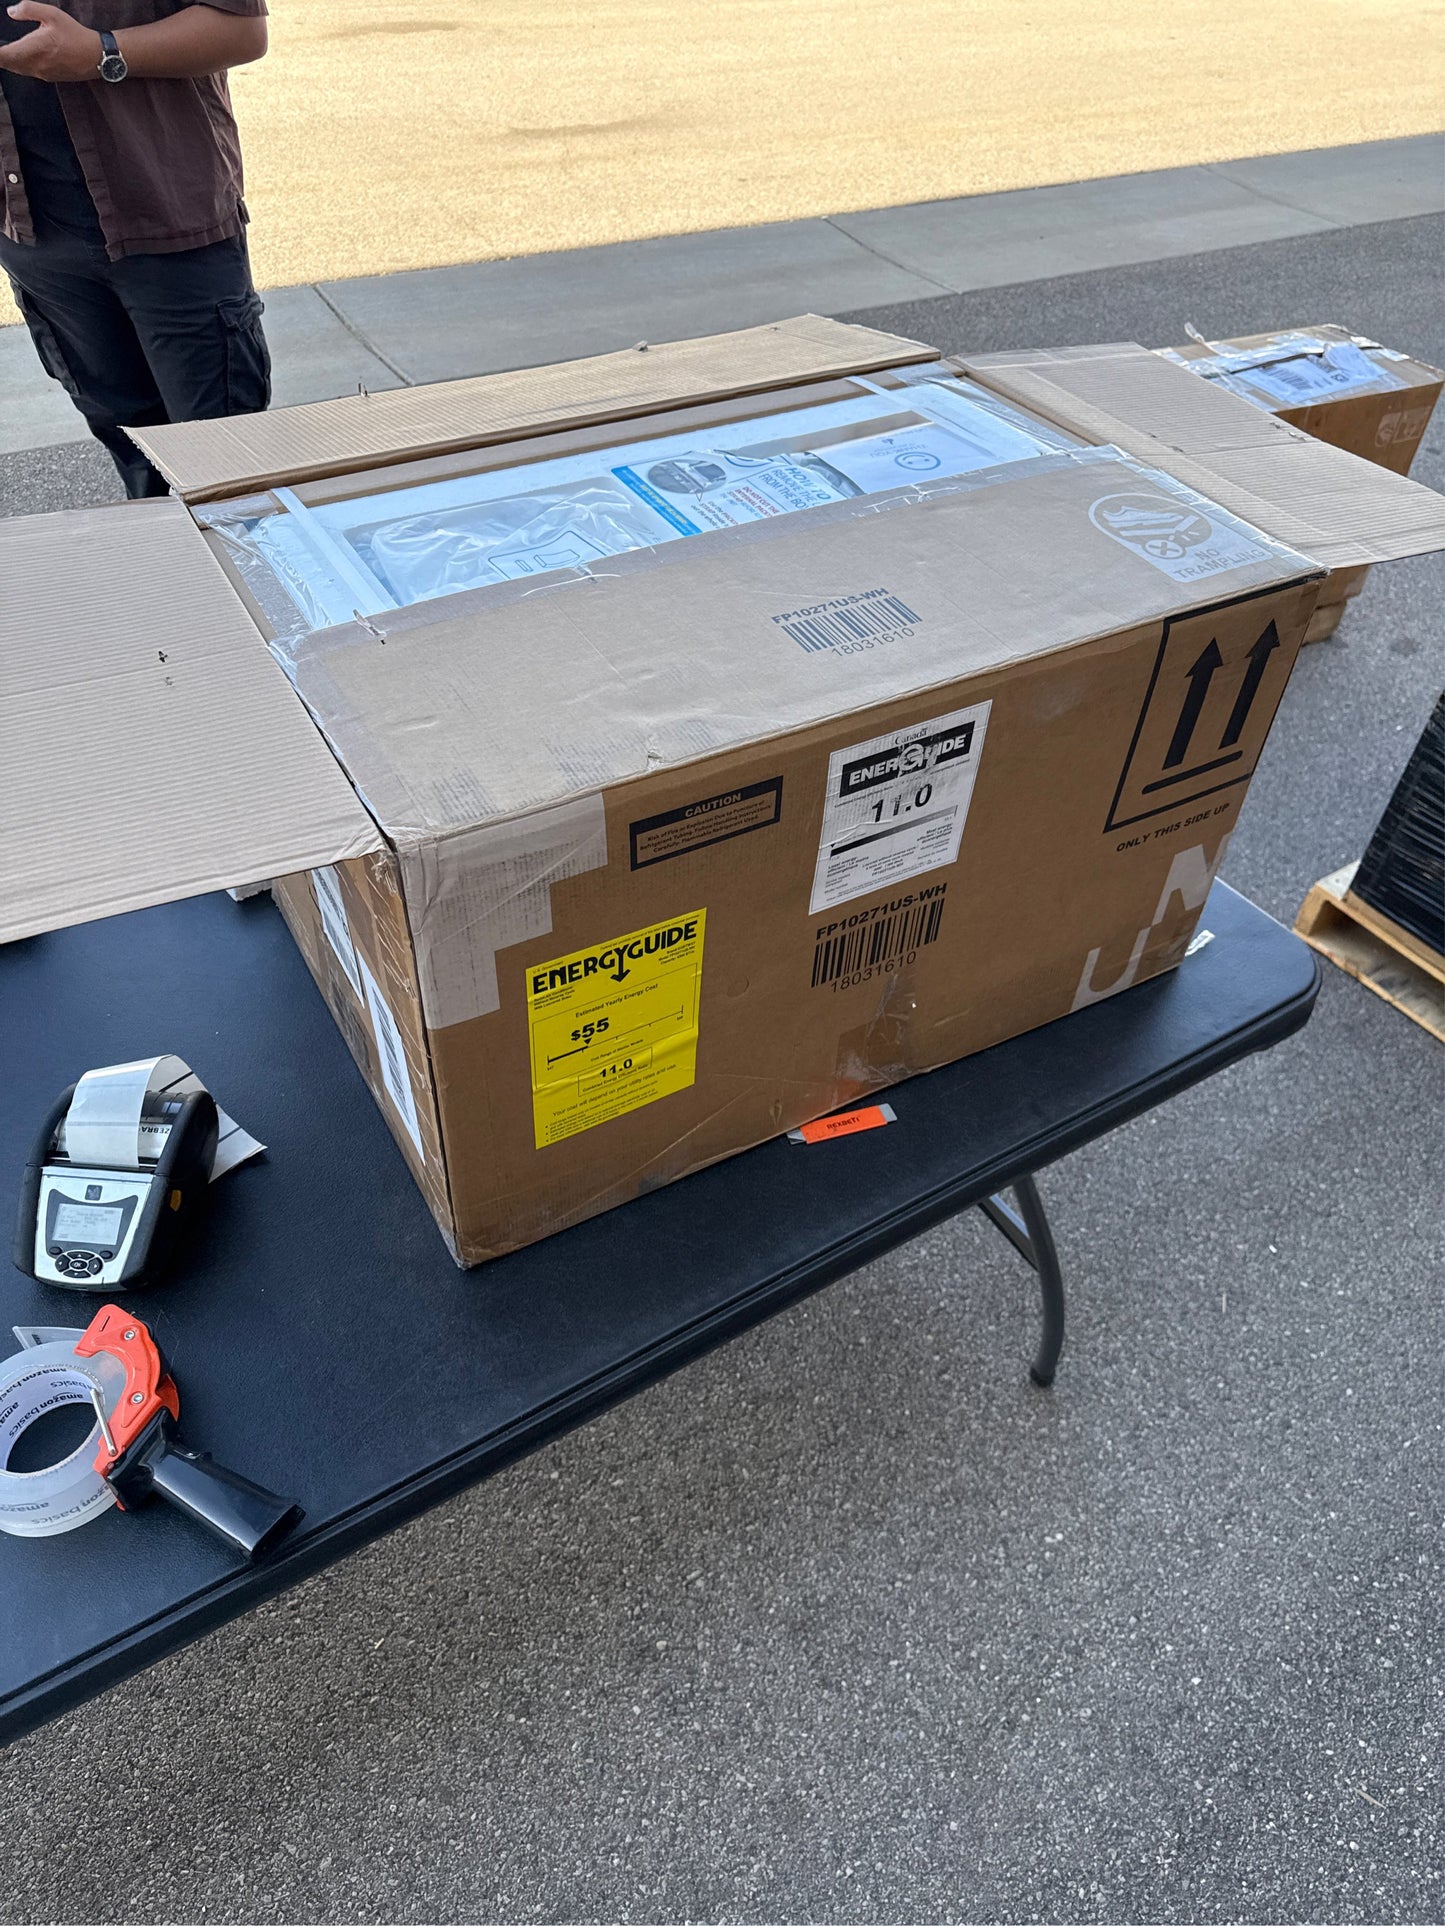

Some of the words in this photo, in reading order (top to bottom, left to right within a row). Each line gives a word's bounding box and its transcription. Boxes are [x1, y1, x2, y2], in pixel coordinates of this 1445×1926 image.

[759, 474, 783, 491] FROM
[780, 490, 797, 501] THE
[785, 467, 815, 488] HOW
[811, 487, 831, 500] TO
[1173, 549, 1265, 579] TRAMPLING
[1194, 548, 1221, 560] NO
[771, 588, 889, 624] FP10271US-WH
[832, 627, 915, 657] 18031610
[685, 792, 741, 817] CAUTION
[871, 783, 932, 823] 11.0
[1116, 833, 1150, 852] ONLY
[1153, 822, 1181, 838] THIS
[1184, 810, 1212, 827] SIDE
[1213, 803, 1230, 816] UP
[816, 882, 947, 940] FP10271US-WH
[532, 919, 697, 995] ENERGYGUIDE
[831, 951, 917, 993] 18031610
[575, 1002, 603, 1018] Estimated
[605, 995, 622, 1008] Yearly
[624, 988, 643, 1001] Energy
[645, 982, 658, 992] Cost
[570, 1017, 610, 1042] $55
[599, 1059, 633, 1078] 11.0
[553, 1108, 564, 1117] Your
[141, 1126, 170, 1134] ZEBRA
[22, 1367, 67, 1382] amazon
[50, 1380, 87, 1390] basics
[40, 1392, 84, 1409] amazon
[9, 1407, 40, 1438] basics
[31, 1505, 82, 1524] basics
